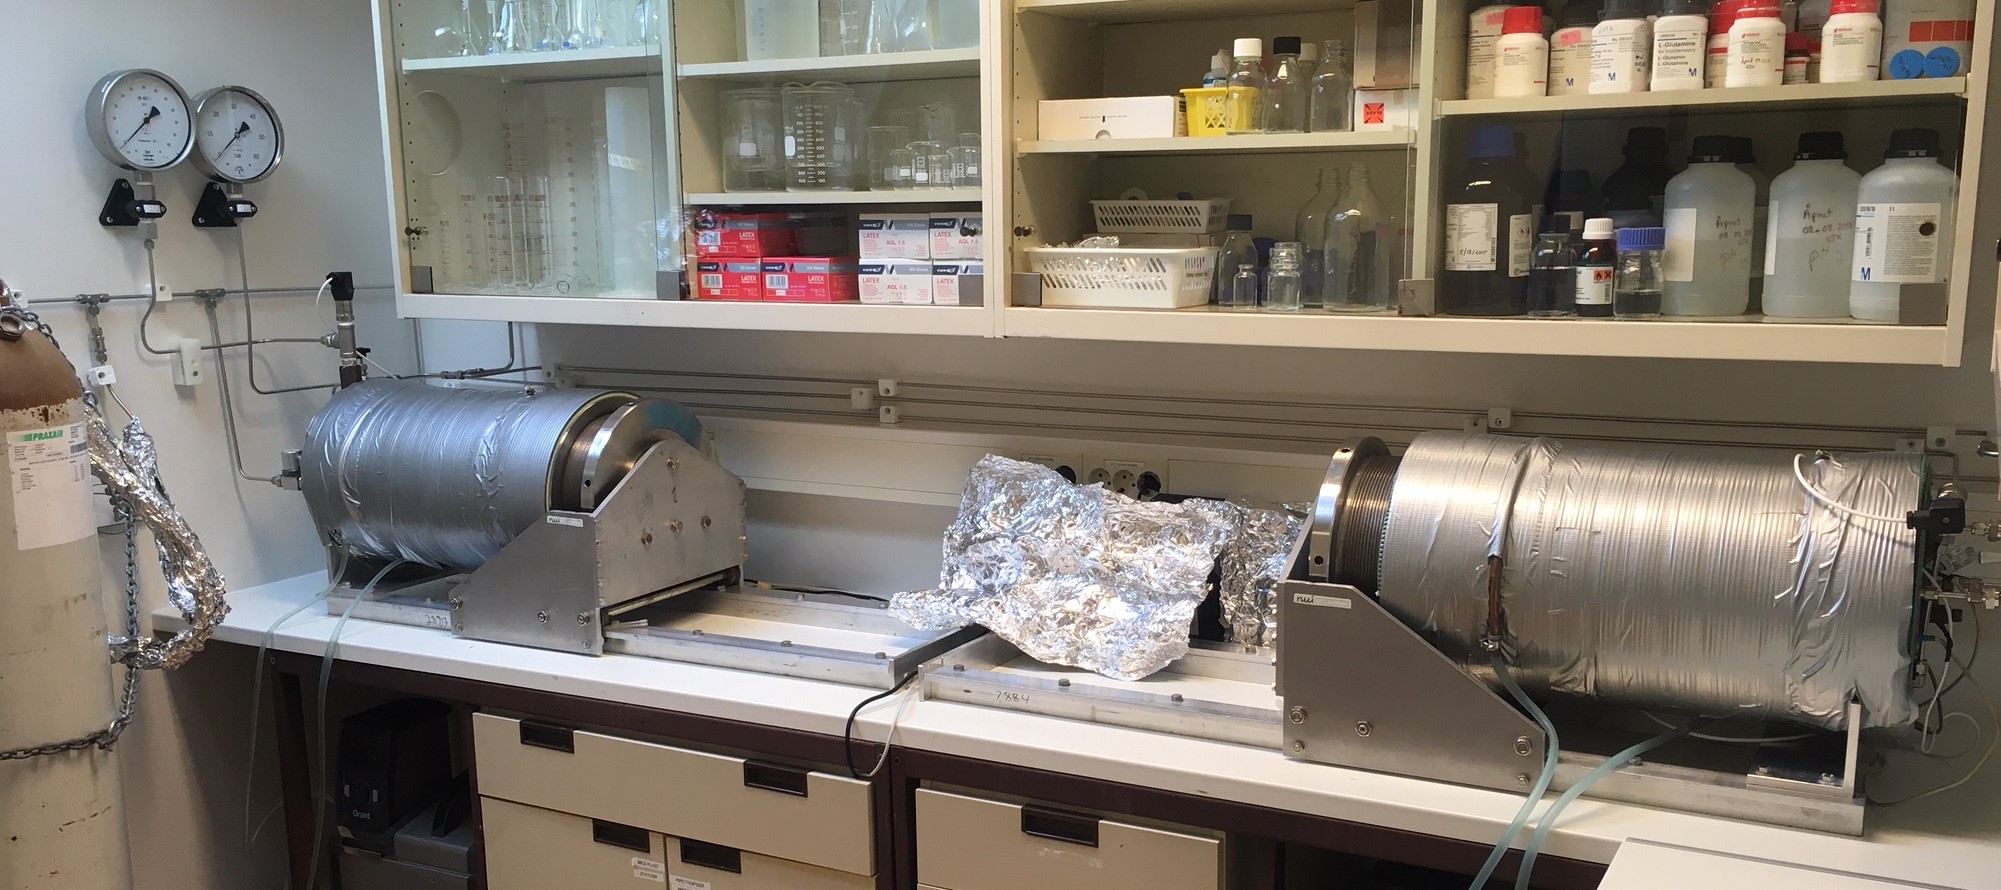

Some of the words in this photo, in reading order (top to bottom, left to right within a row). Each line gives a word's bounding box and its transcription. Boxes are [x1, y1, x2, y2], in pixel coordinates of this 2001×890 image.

[1689, 68, 1697, 76] M
[1862, 267, 1871, 280] M
[33, 430, 63, 440] PRAXAIR
[353, 809, 370, 820] Grant
